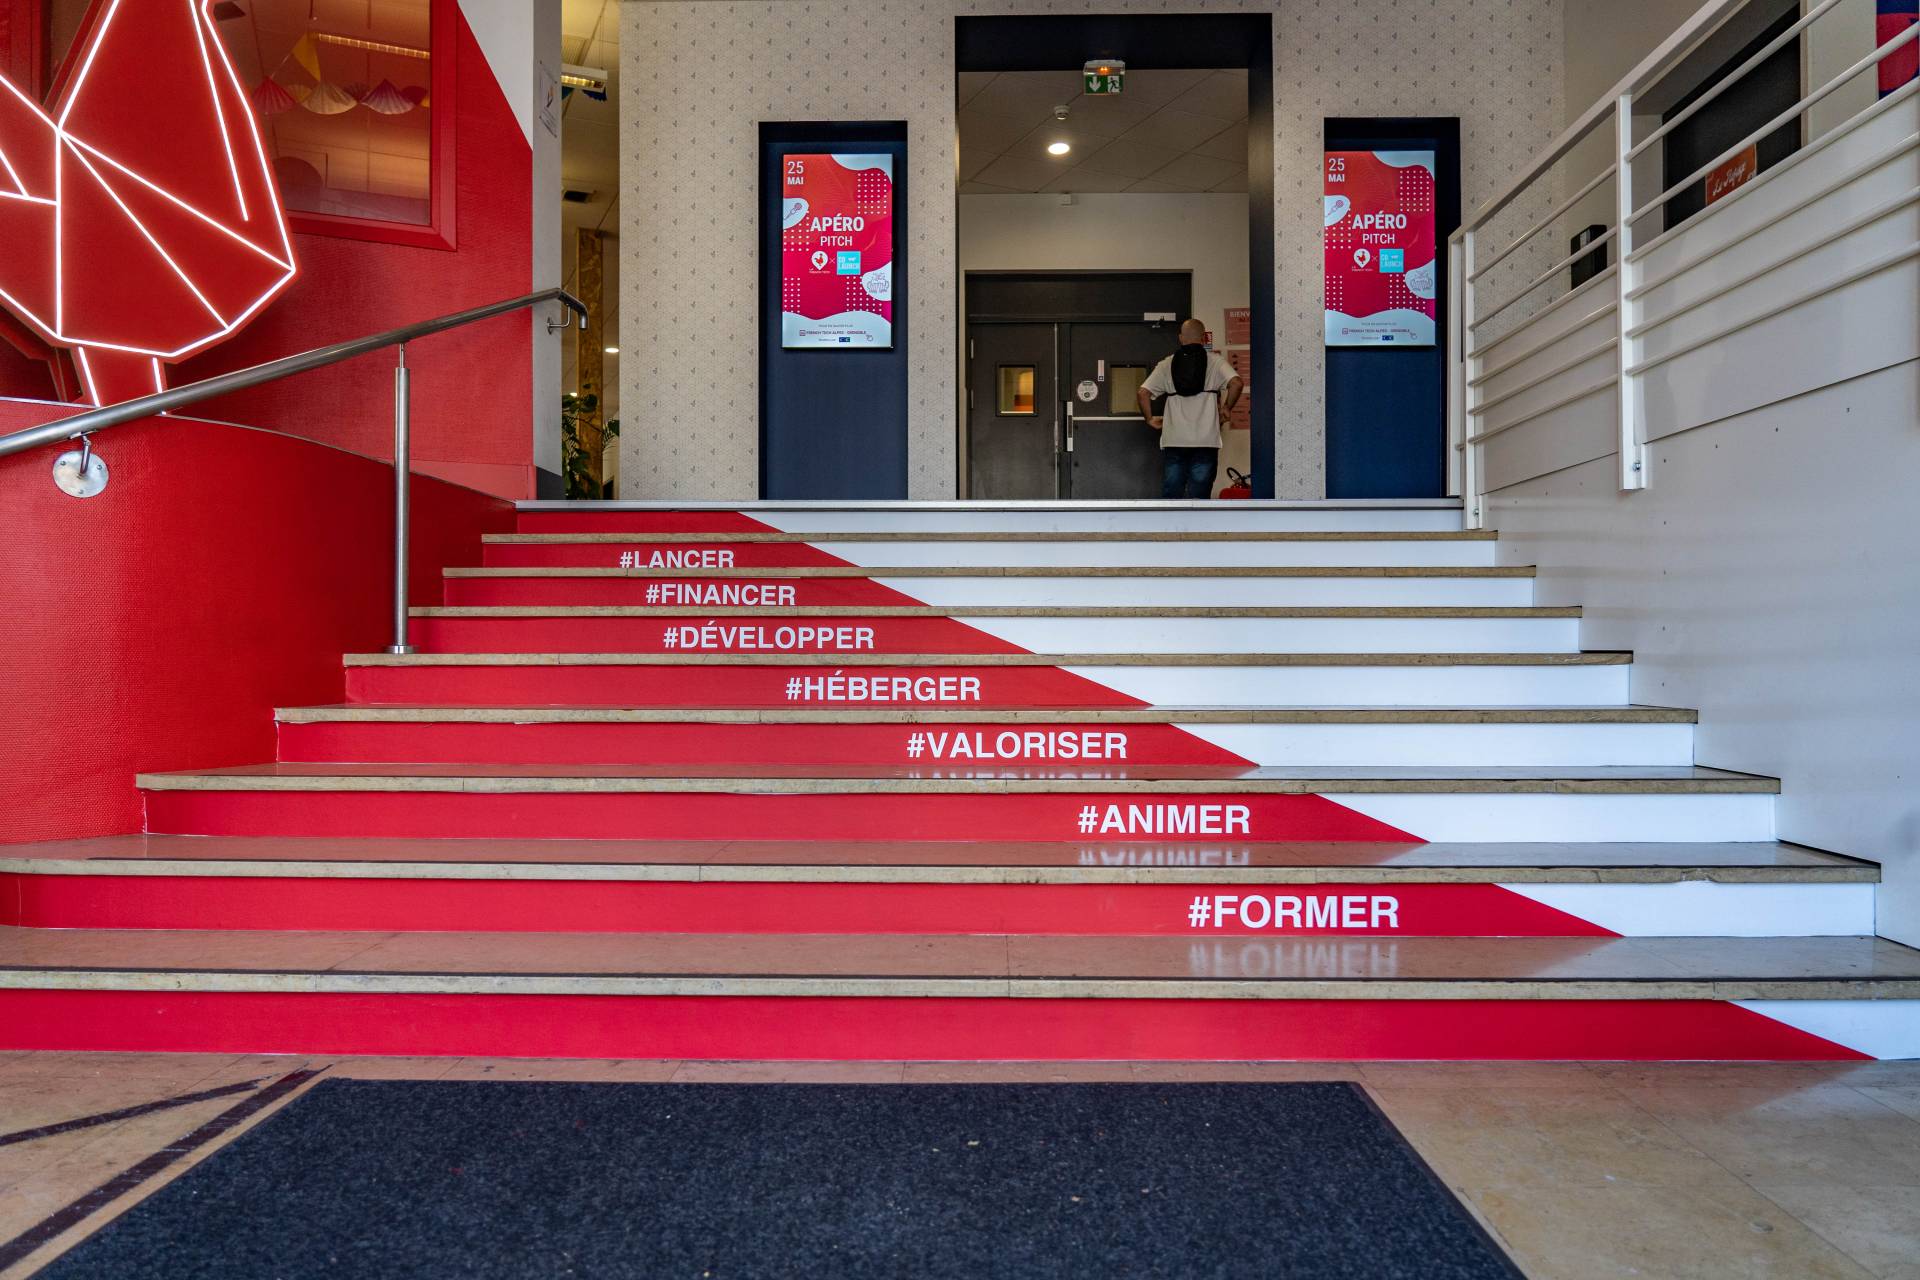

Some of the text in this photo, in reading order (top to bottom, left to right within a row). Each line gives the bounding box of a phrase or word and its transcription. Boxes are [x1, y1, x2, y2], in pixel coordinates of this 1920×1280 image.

[787, 161, 804, 174] 25
[1328, 158, 1345, 171] 25
[787, 177, 804, 185] MAI
[1328, 174, 1345, 182] MAI
[810, 213, 864, 232] APÉRO
[1352, 210, 1407, 229] APÉRO
[820, 236, 853, 246] PITCH
[1362, 233, 1395, 244] PITCH
[620, 550, 734, 568] #LANCER
[646, 584, 795, 605] #FINANCER
[663, 621, 874, 649] #DÉVELOPPER
[786, 670, 980, 701] #HÉBERGER
[907, 732, 1127, 758] #VALORISER
[1078, 805, 1250, 833] #ANIMER
[1188, 895, 1398, 928] #FORMER
